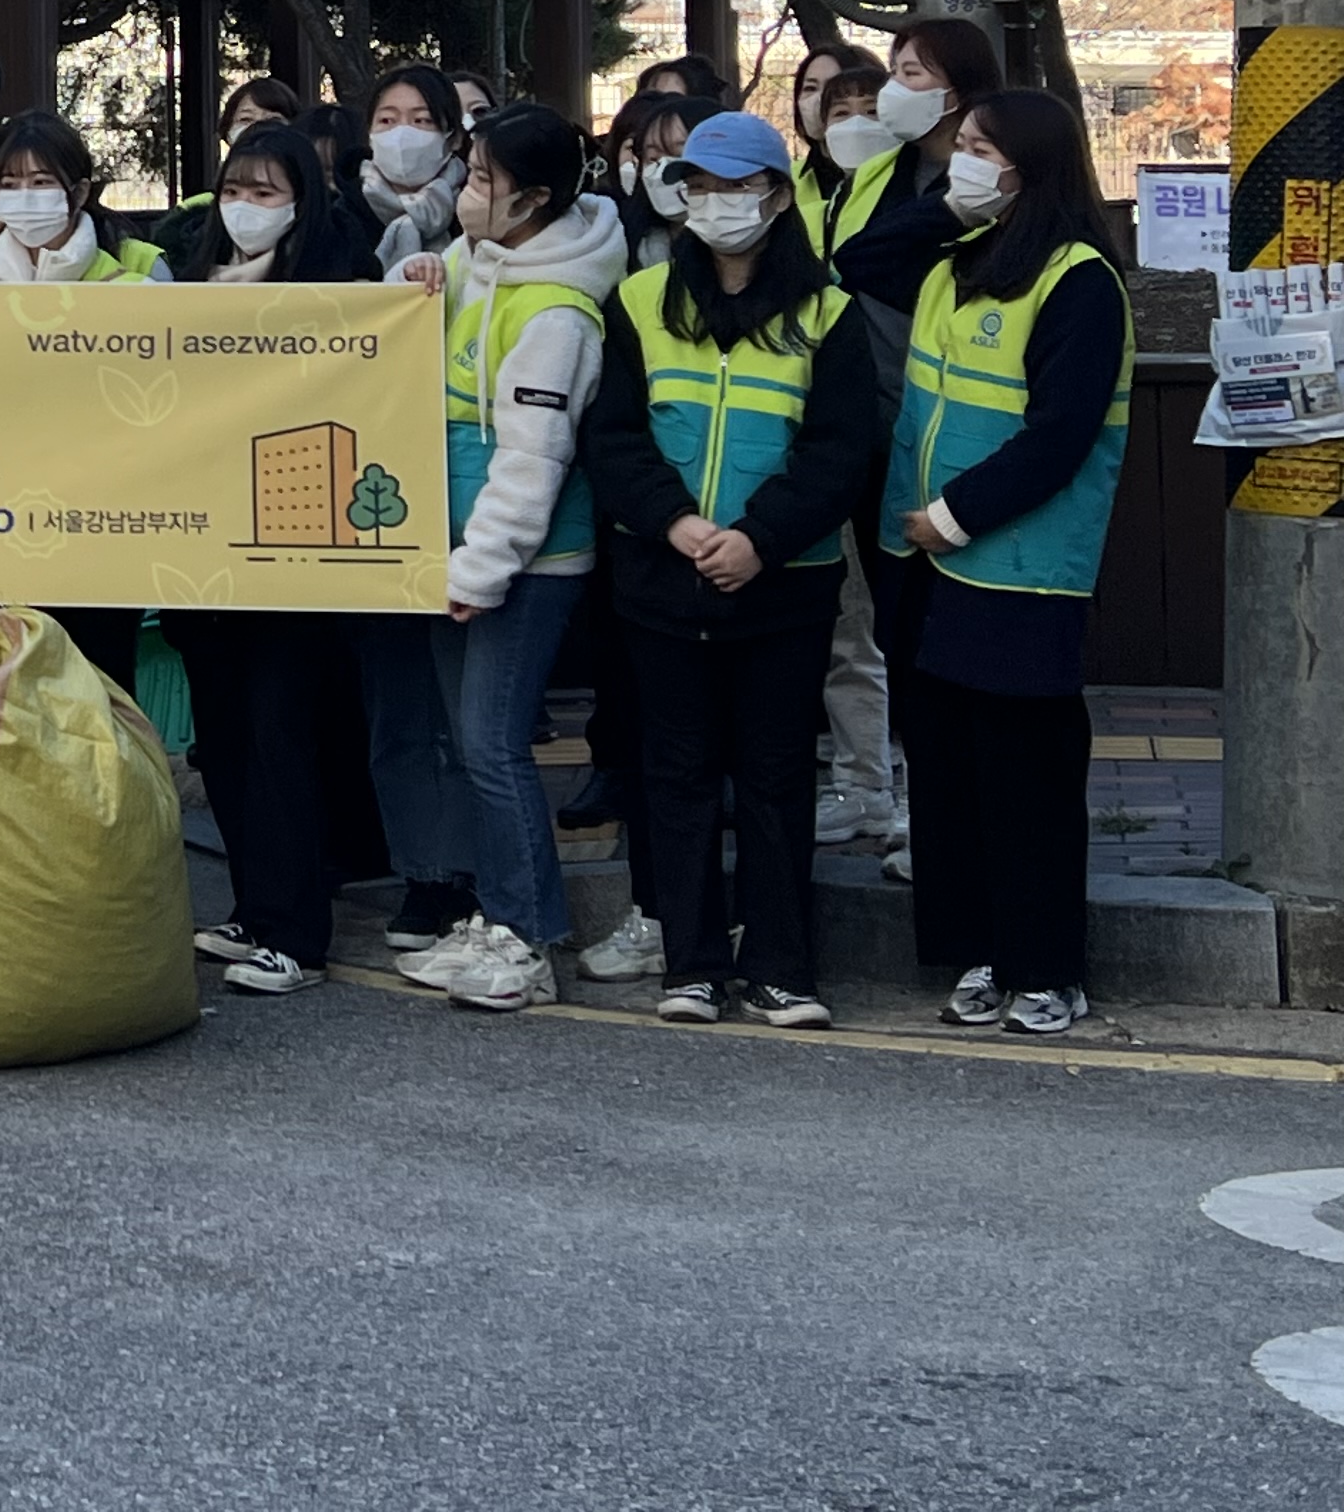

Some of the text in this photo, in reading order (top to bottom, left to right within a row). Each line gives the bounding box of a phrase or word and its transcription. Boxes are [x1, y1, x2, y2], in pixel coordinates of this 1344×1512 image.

[1155, 185, 1207, 217] 공원
[27, 330, 379, 360] watv.org asezwao.org
[43, 510, 210, 535] 서울강남남부지부
